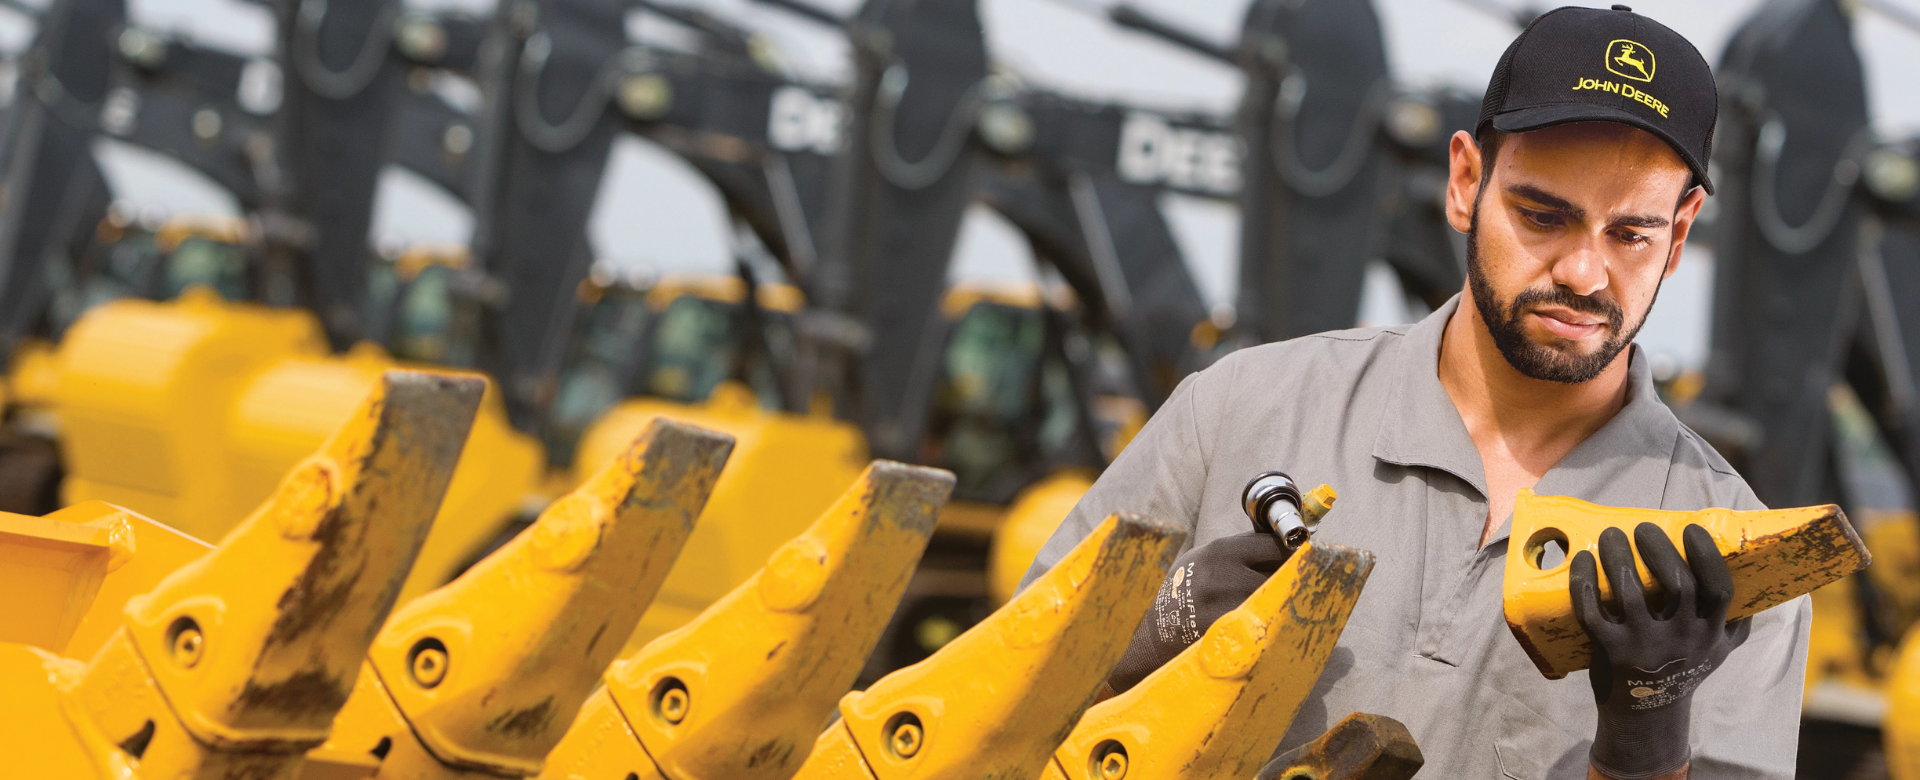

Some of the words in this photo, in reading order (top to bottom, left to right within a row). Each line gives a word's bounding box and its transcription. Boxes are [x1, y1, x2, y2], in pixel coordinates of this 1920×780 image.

[1572, 77, 1620, 94] JOHN
[1621, 83, 1670, 119] DEERE
[1186, 562, 1200, 638] MaxiFlex
